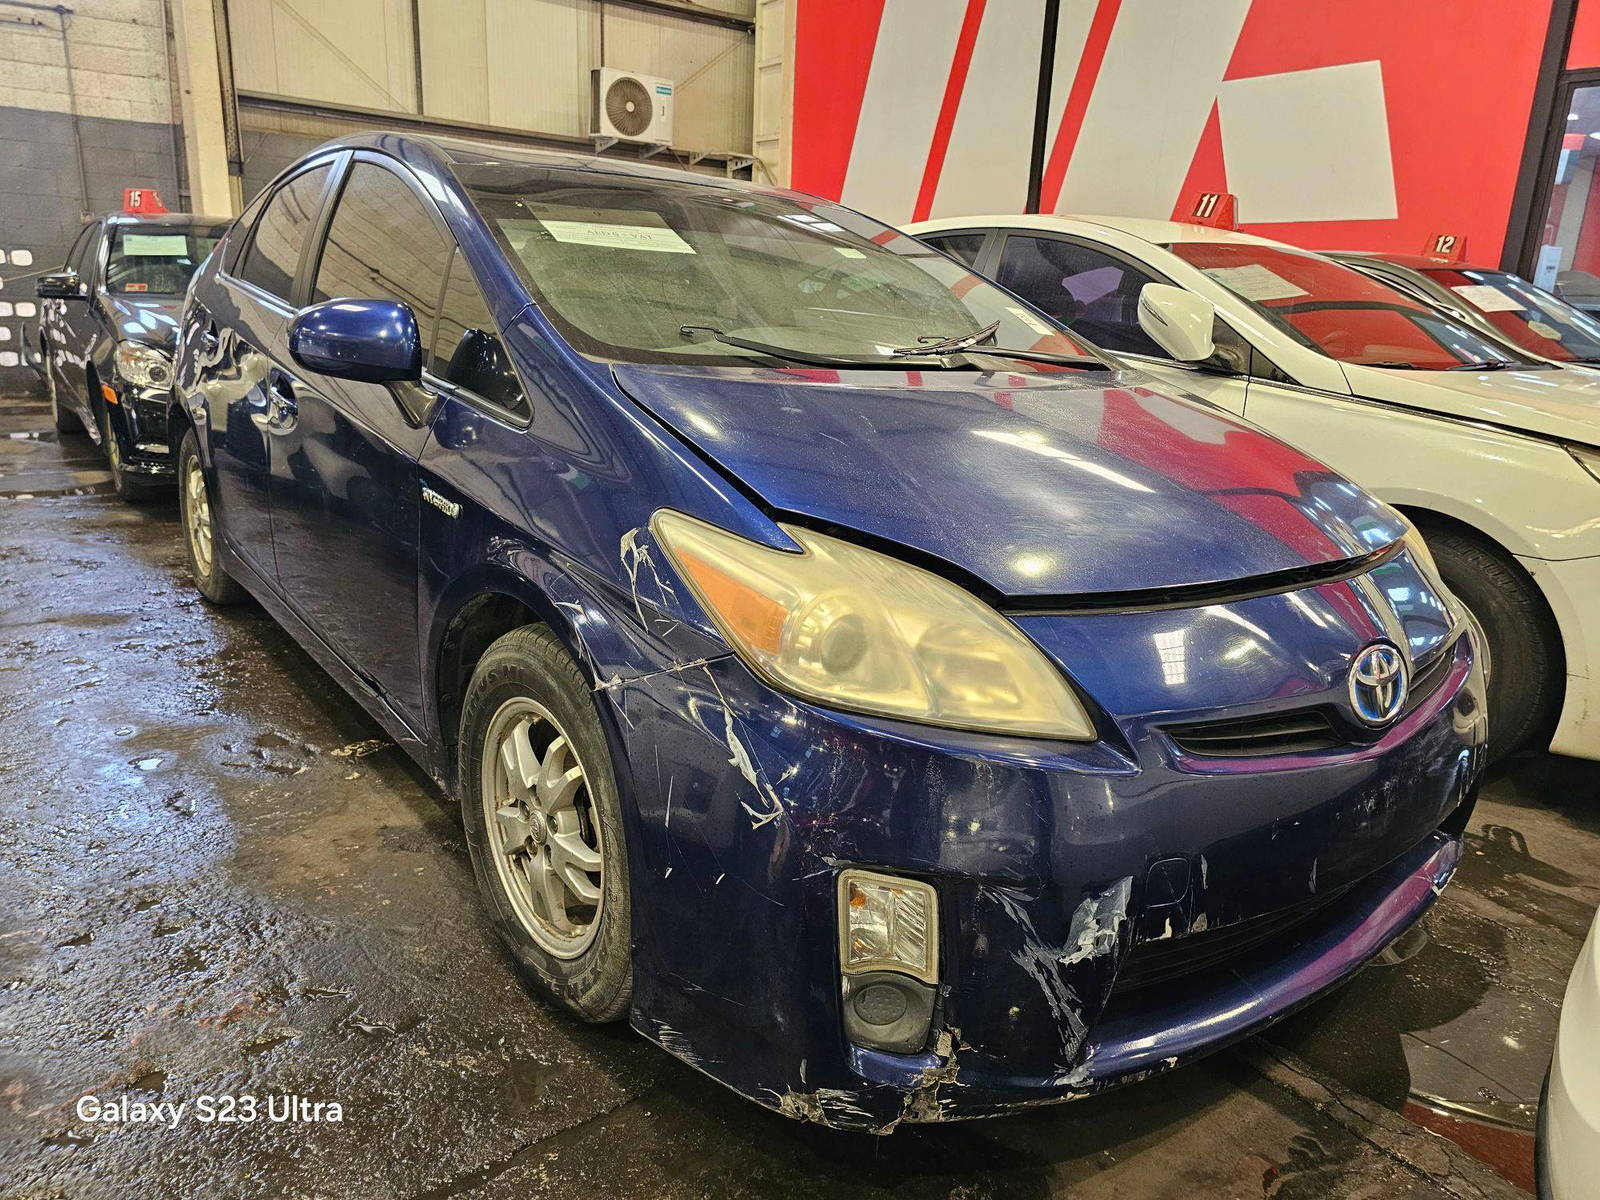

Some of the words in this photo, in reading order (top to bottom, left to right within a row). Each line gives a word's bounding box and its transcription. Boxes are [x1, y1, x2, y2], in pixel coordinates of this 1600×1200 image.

[129, 190, 142, 207] 15
[1196, 193, 1219, 218] 11
[1435, 235, 1455, 254] 12
